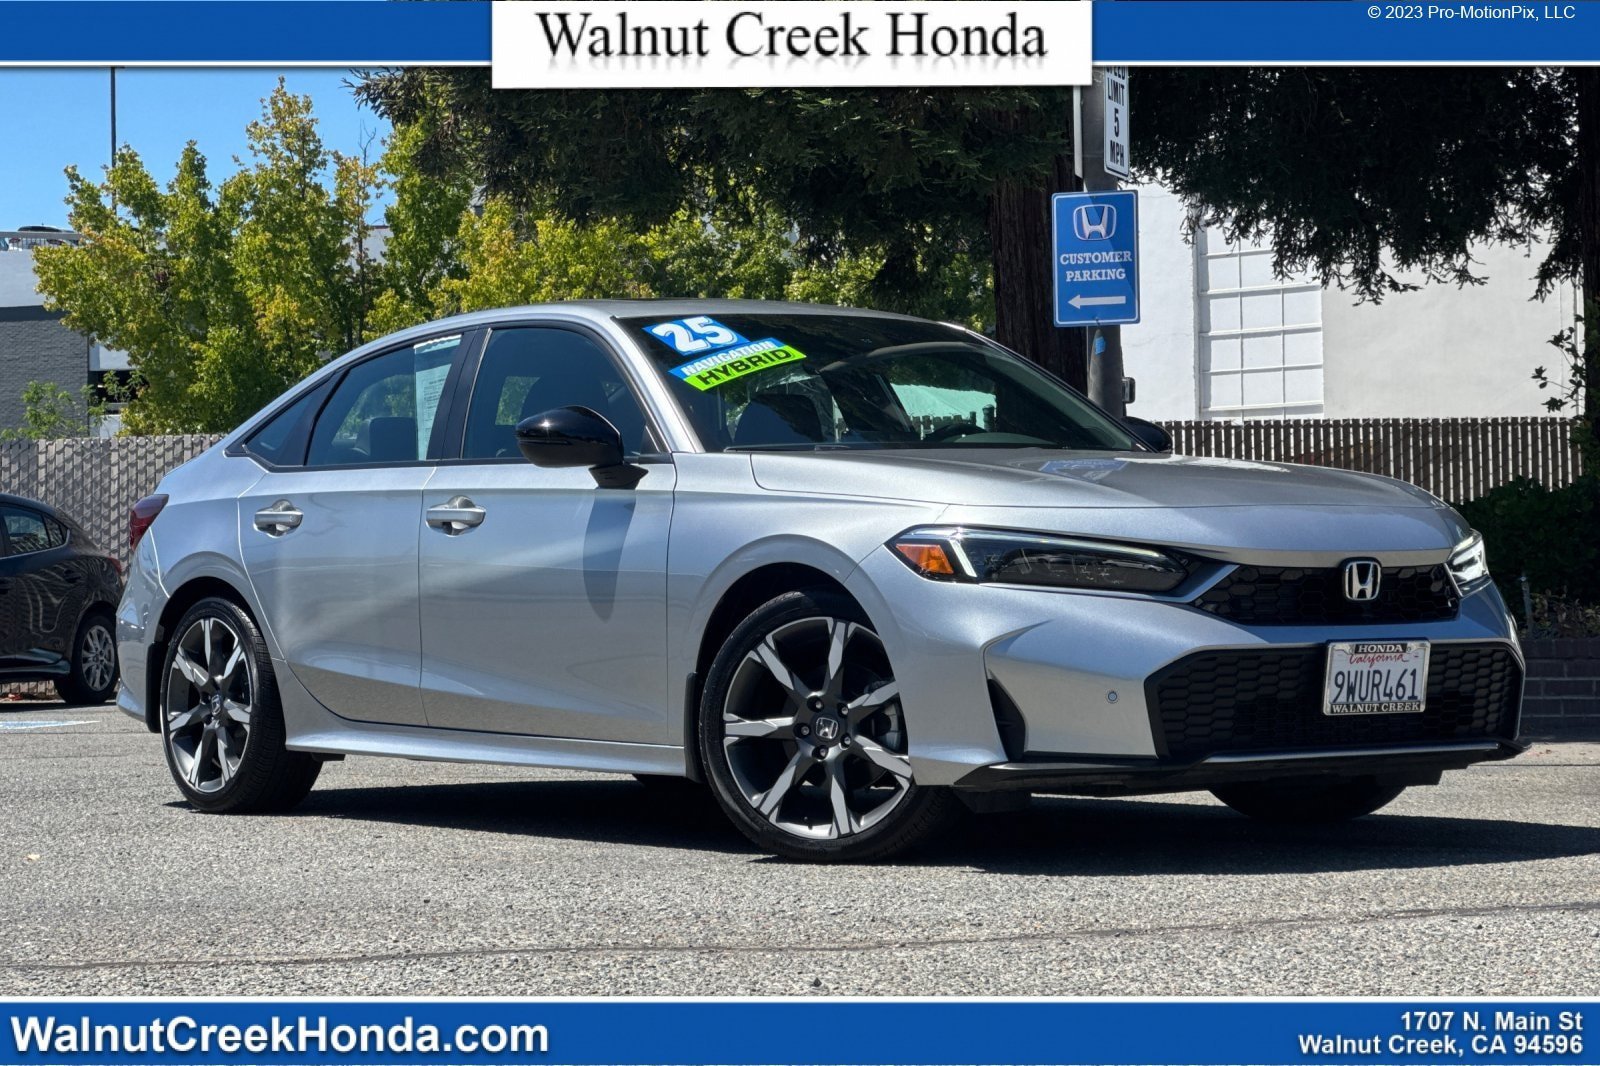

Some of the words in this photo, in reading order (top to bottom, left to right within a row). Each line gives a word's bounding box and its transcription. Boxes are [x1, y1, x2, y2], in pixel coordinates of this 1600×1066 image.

[1107, 77, 1125, 106] LIMIT
[1113, 107, 1120, 138] 5
[1109, 140, 1125, 167] MPH
[1060, 251, 1132, 265] CUSTOMER
[1066, 268, 1126, 282] PARKING
[651, 315, 739, 352] 25
[680, 340, 777, 376] NAVIGATION
[696, 348, 792, 386] HYBRID
[1349, 653, 1409, 668] California
[1358, 644, 1403, 653] HONDA
[1332, 668, 1418, 703] 9WUR461
[1332, 703, 1380, 713] WALNUT
[1381, 702, 1420, 712] CREEK
